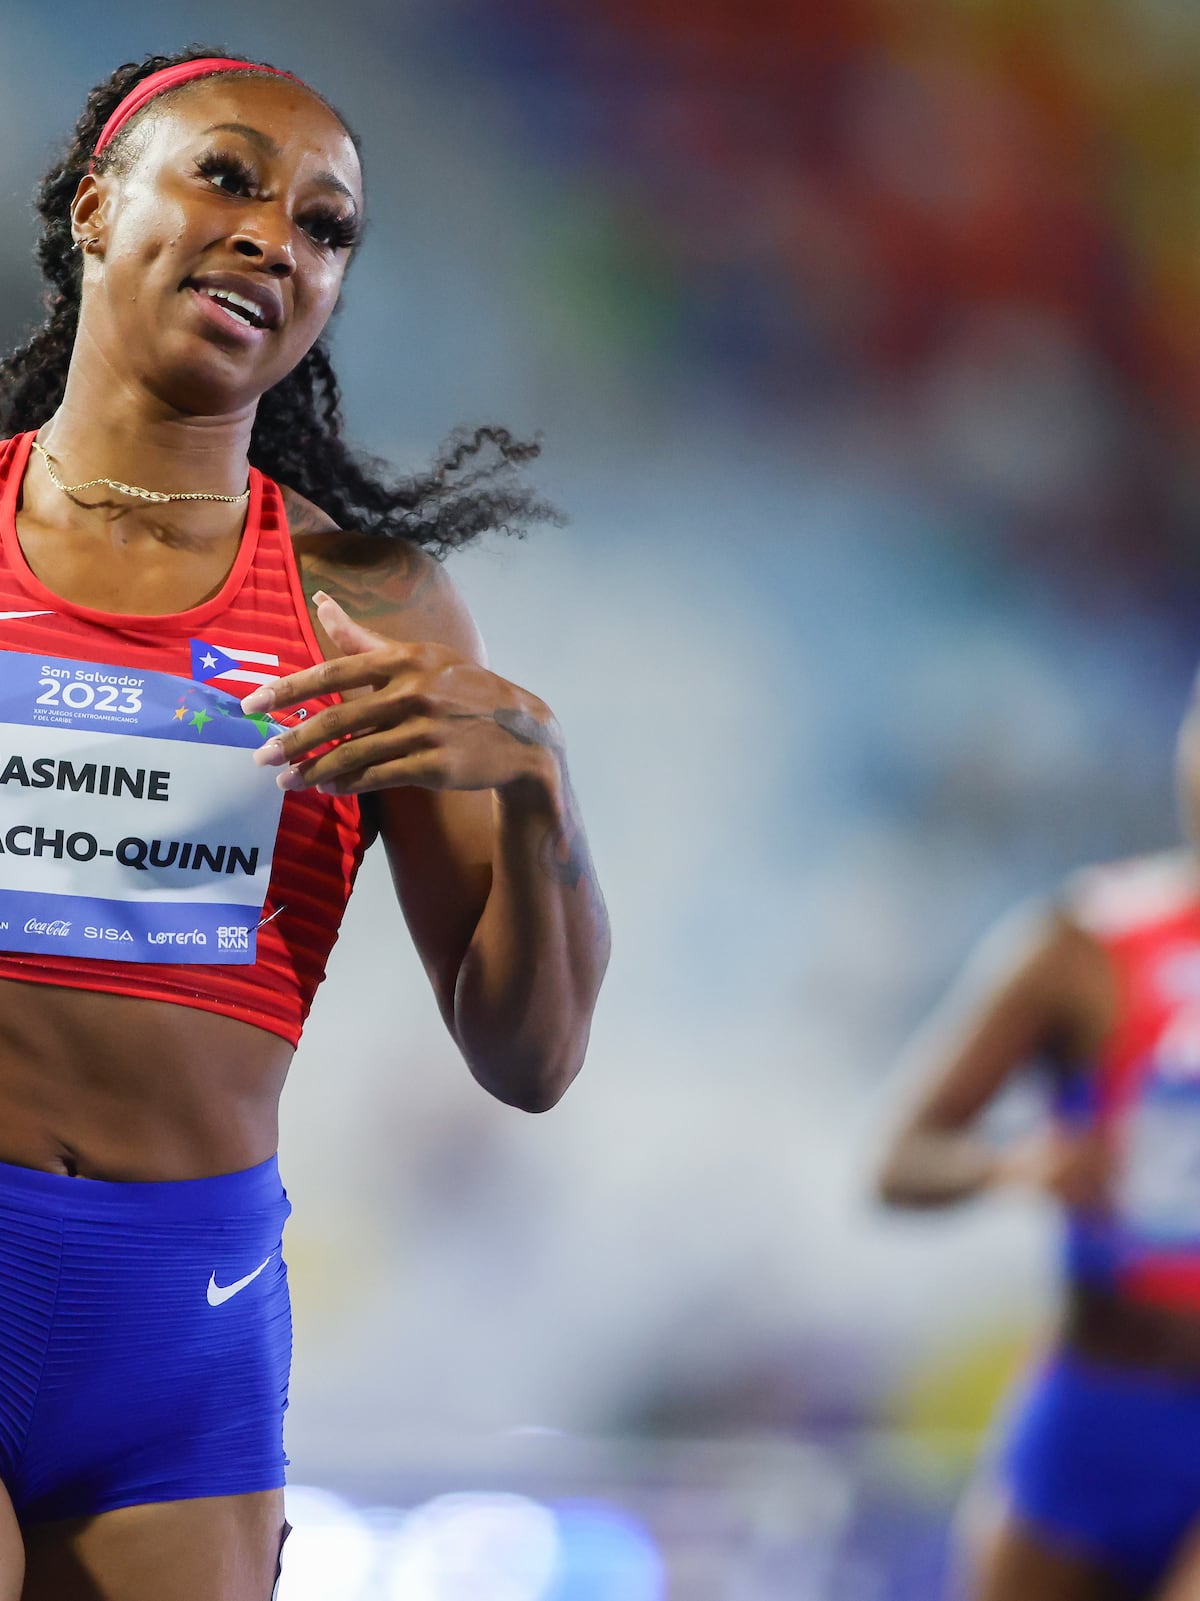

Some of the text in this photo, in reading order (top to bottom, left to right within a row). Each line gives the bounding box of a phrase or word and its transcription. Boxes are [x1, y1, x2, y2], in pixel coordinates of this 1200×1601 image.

[40, 665, 145, 687] San Salvador
[36, 679, 143, 714] 2023
[74, 712, 138, 724] CENTROAMERICANOS
[23, 917, 73, 937] Coca-Cola
[84, 927, 133, 941] SISA
